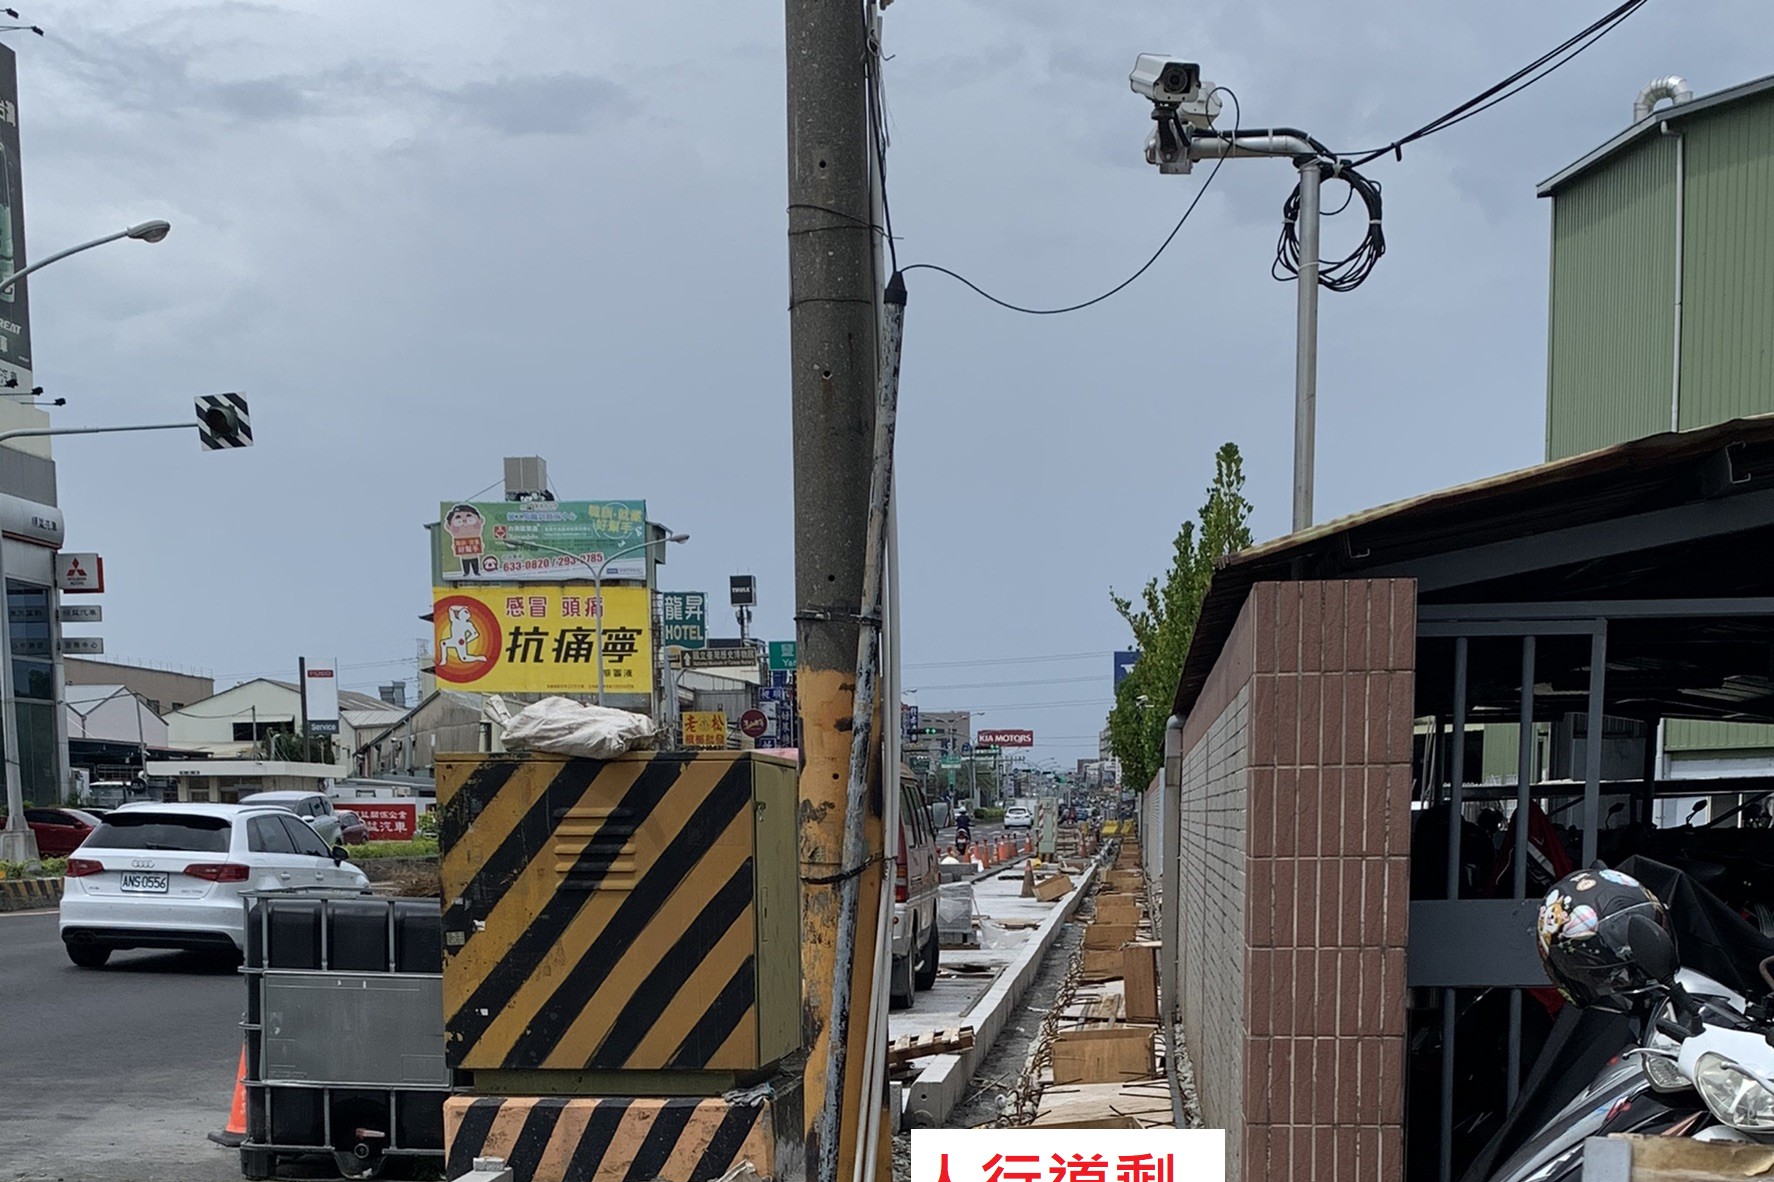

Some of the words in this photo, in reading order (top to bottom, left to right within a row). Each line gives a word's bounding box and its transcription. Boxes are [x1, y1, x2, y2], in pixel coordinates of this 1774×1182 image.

[503, 556, 549, 572] 633-0820
[506, 596, 547, 617] 感冒
[562, 596, 603, 618] 頭痛
[664, 595, 703, 621] 龍昇
[665, 625, 704, 641] HOTEL
[506, 626, 643, 663] 抗痛寧
[311, 723, 336, 731] Service
[979, 735, 993, 743] KIA
[995, 734, 1032, 744] MOTORS
